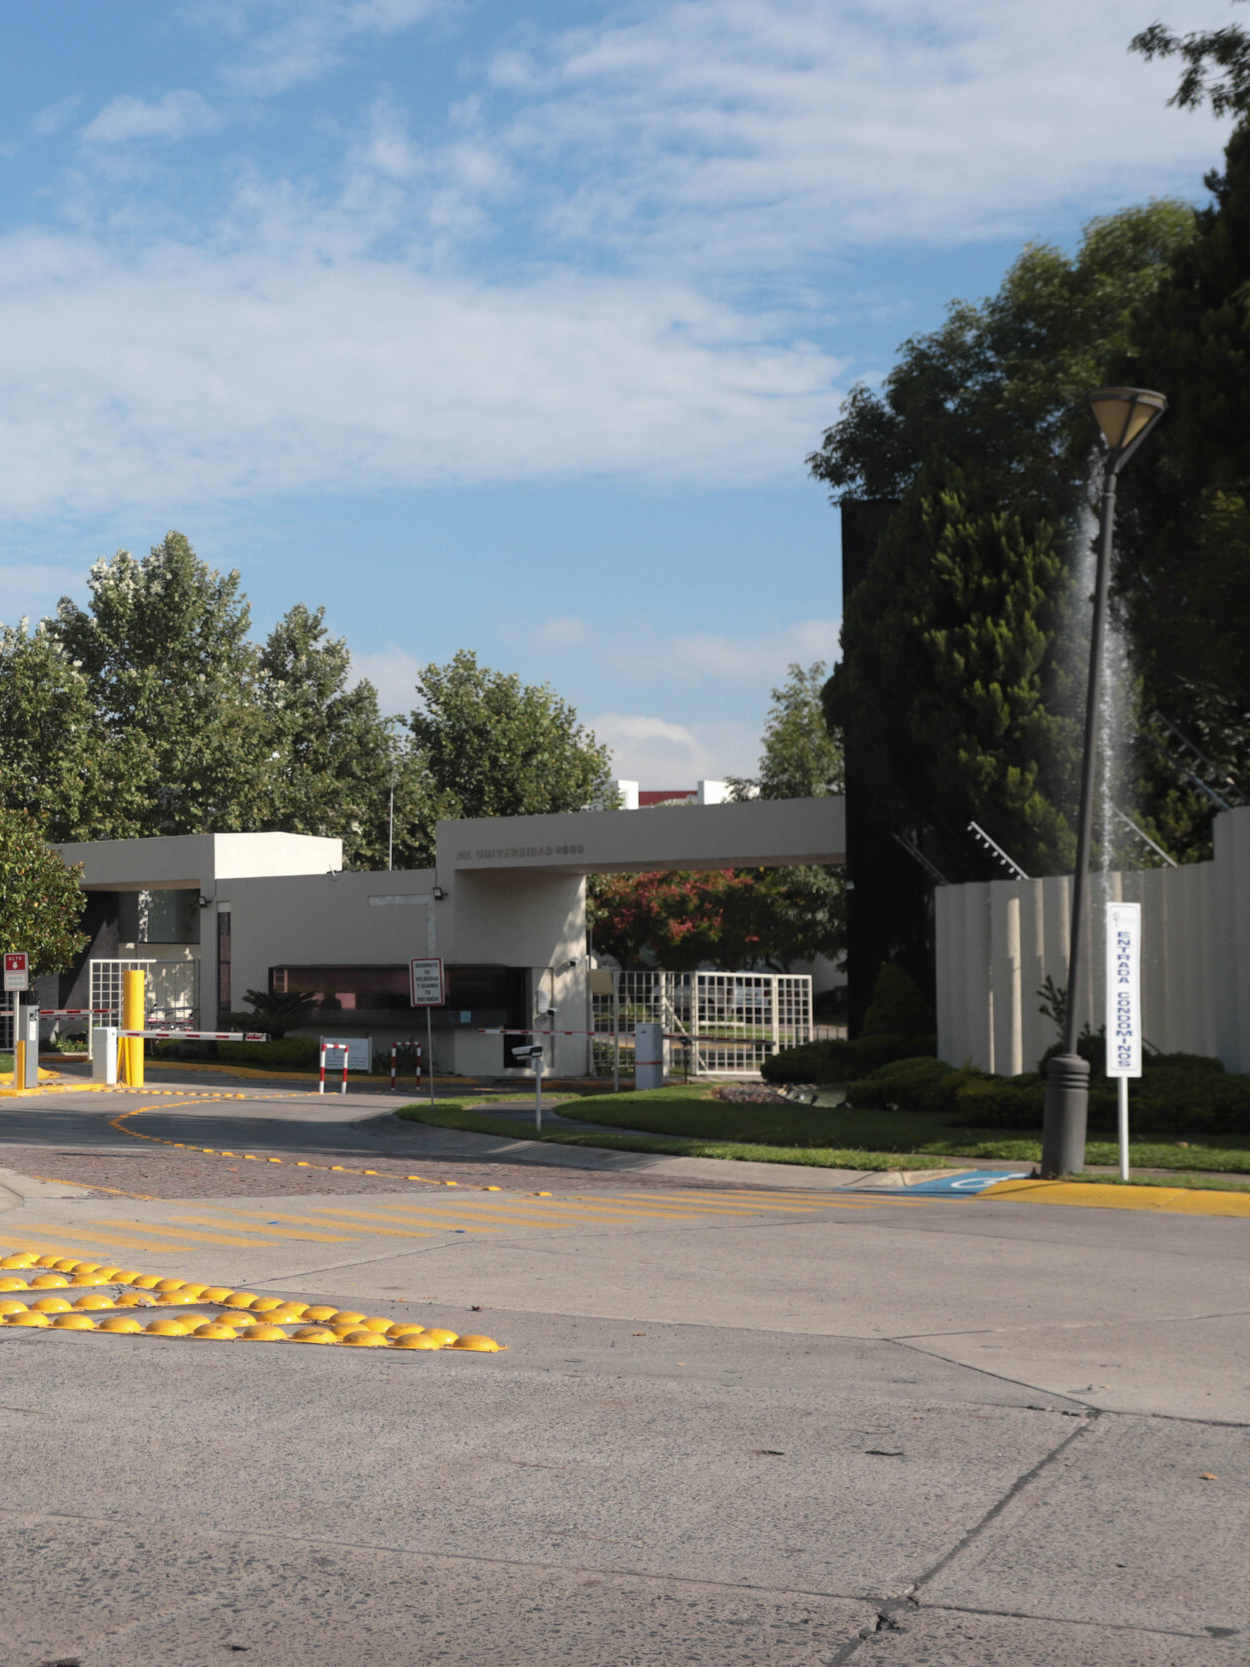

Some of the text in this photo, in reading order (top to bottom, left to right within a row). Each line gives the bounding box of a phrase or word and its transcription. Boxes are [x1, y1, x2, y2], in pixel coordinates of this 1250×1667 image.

[476, 846, 554, 859] UNIVERSIDAD
[1116, 931, 1132, 1068] ENTRADA CONDOMINOS
